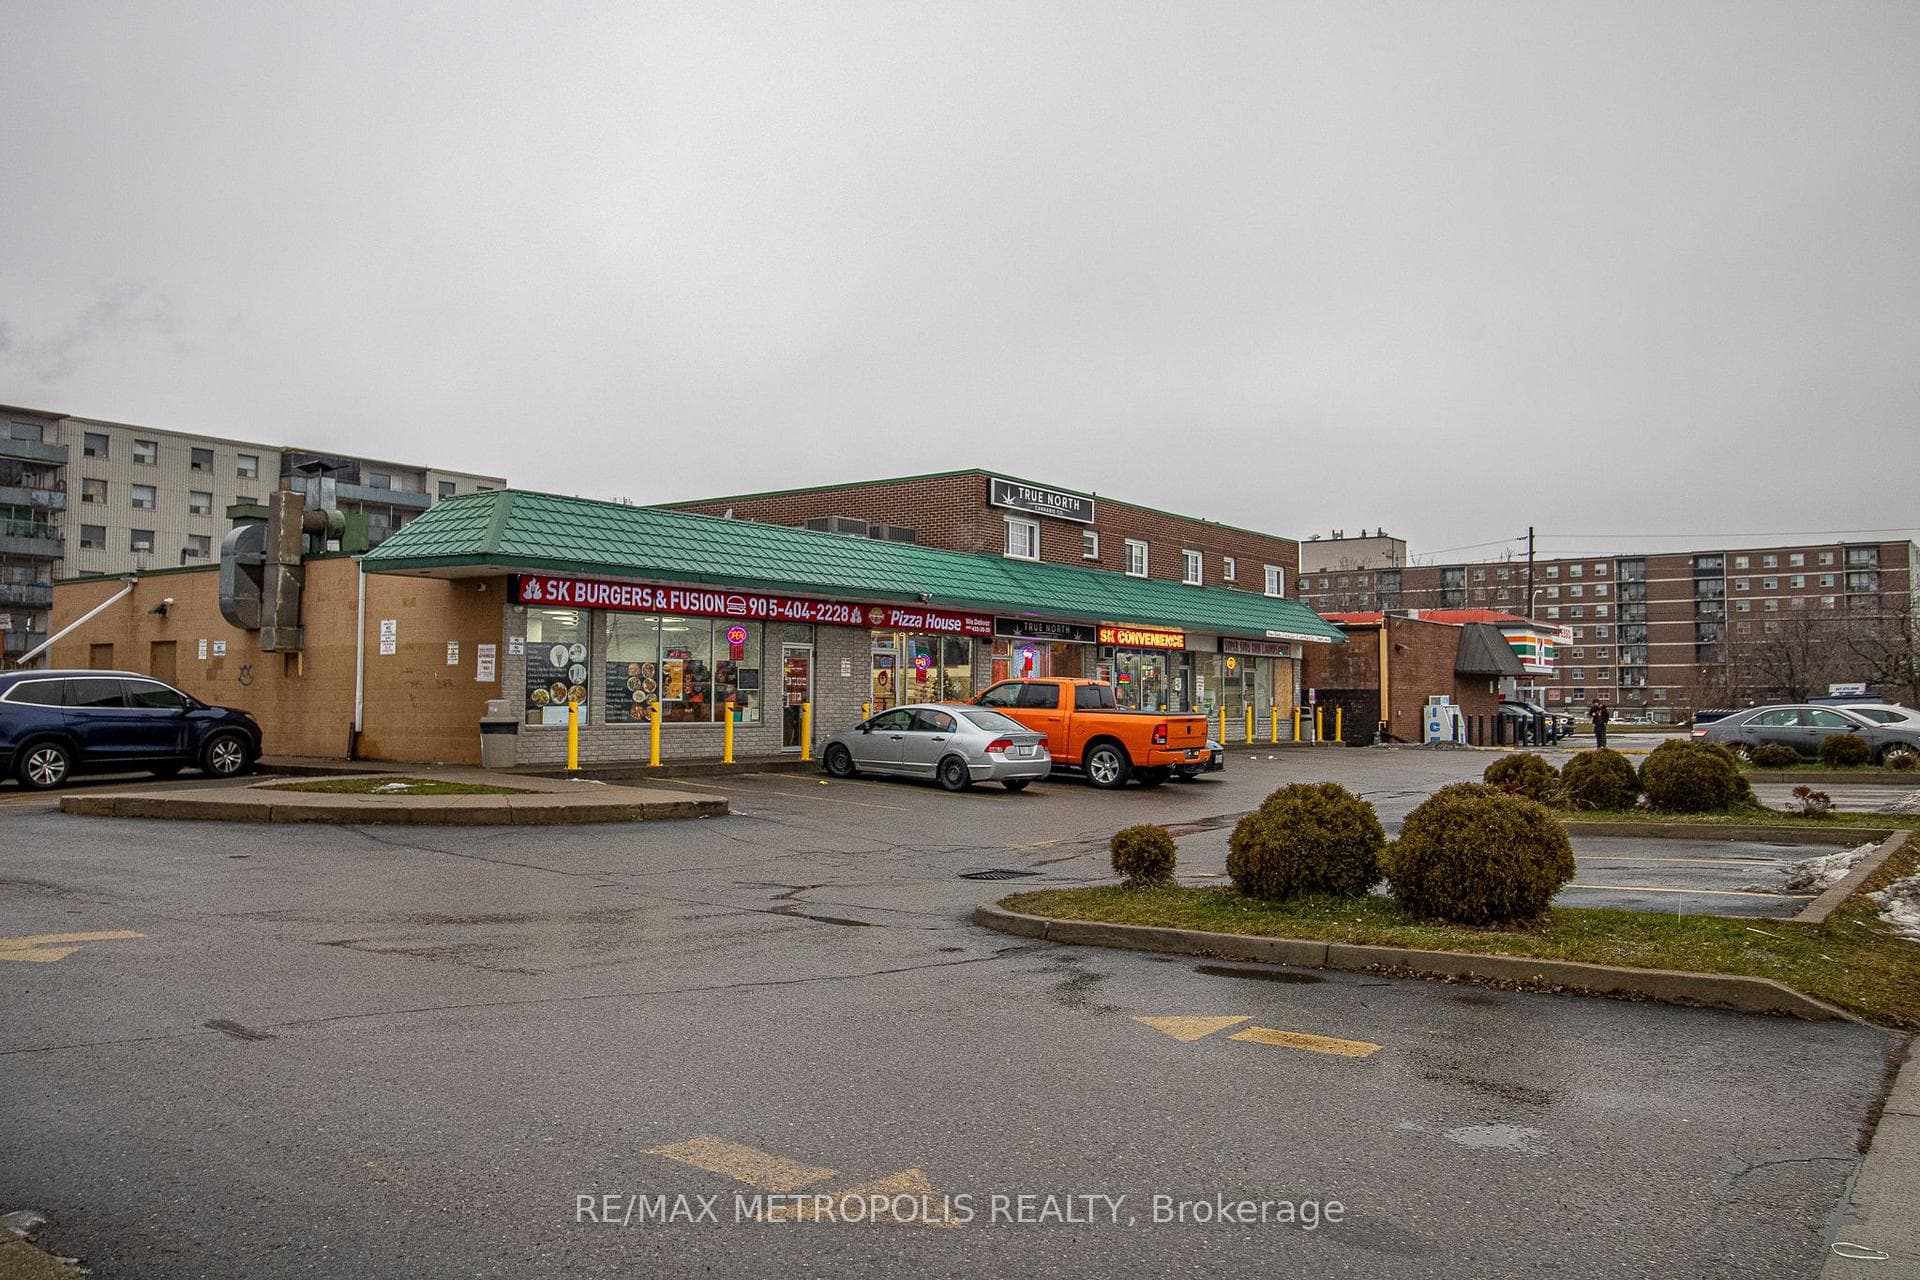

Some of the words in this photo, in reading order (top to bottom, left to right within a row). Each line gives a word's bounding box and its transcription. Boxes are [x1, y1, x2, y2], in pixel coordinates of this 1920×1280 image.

[1018, 487, 1043, 503] TRUE
[1047, 493, 1080, 511] NORTH
[546, 580, 570, 602] SK
[574, 583, 652, 607] BURGERS
[655, 590, 667, 608] &
[670, 591, 725, 613] FUSION
[750, 597, 849, 622] 905-404-2228
[890, 610, 922, 628] Pizza
[925, 613, 961, 631] House
[1024, 622, 1043, 632] TRUE
[1046, 623, 1071, 634] NORTH
[1100, 629, 1115, 643] SK
[1118, 630, 1184, 648] CONVENIENCE
